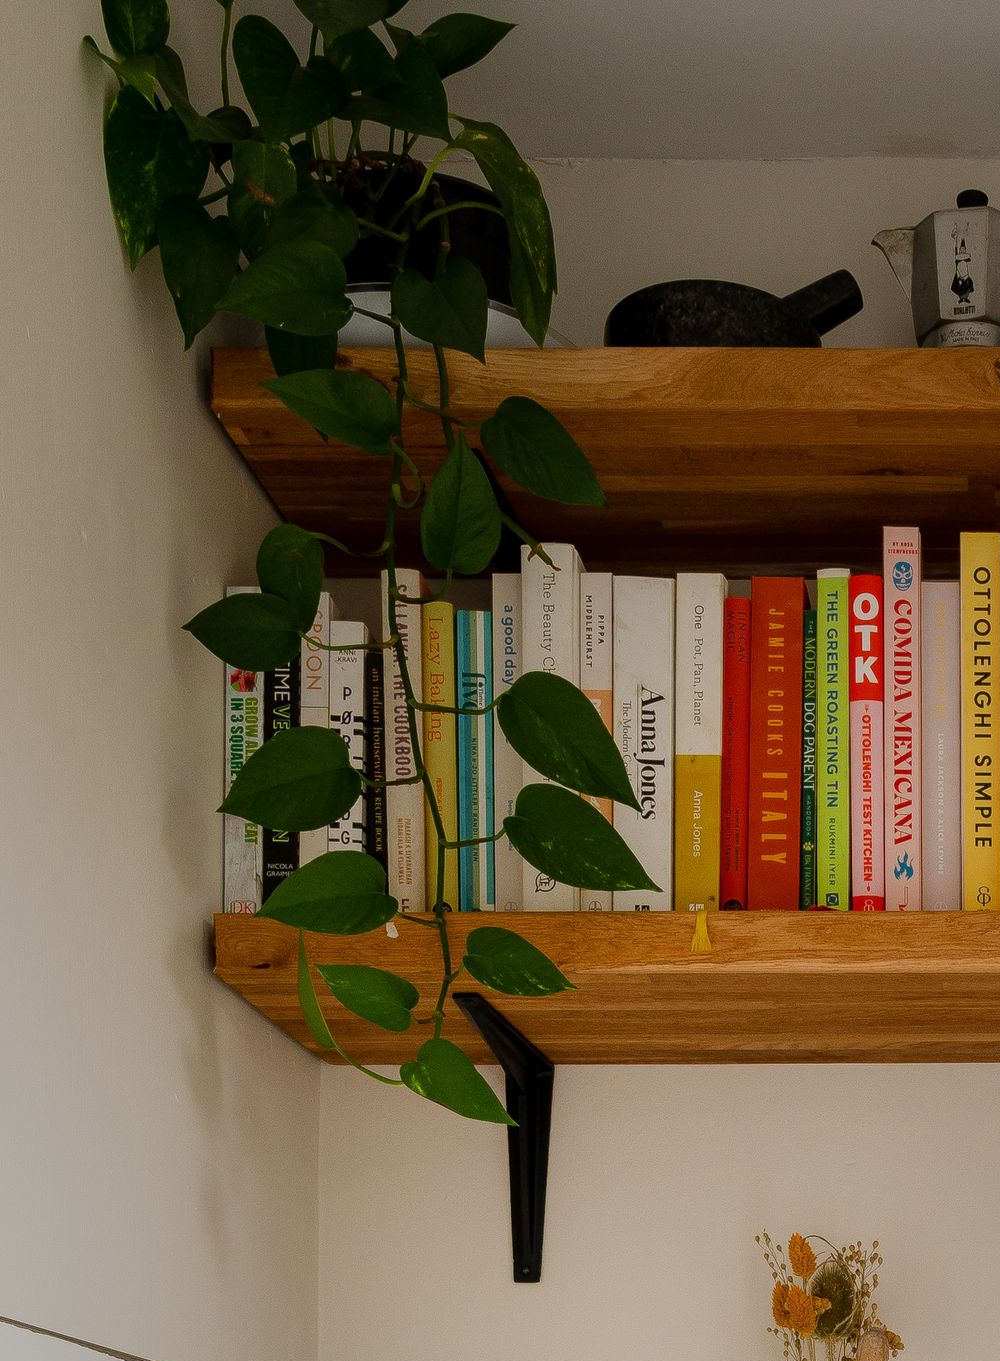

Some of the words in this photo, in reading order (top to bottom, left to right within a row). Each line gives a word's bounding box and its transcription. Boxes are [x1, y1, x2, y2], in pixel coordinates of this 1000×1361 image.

[393, 584, 408, 607] SI
[542, 572, 556, 599] The
[504, 604, 514, 613] a
[694, 605, 705, 630] One
[737, 610, 747, 632] TIN
[826, 590, 839, 623] THE
[424, 616, 444, 666] Lazy
[502, 616, 518, 655] good
[540, 604, 555, 652] Beauty
[585, 595, 593, 668] MIDDLEHURST
[727, 609, 736, 654] MAGIC
[767, 608, 785, 673] JAMIE
[852, 592, 880, 684] OTK
[693, 638, 704, 660] Pot,
[737, 636, 747, 664] CAN
[826, 628, 839, 684] GREEN
[893, 599, 913, 703] COMIDA
[973, 566, 992, 739] OTTOLENGHI
[371, 667, 380, 682] an
[502, 659, 517, 686] day
[692, 663, 704, 688] Pan,
[804, 637, 816, 699] MODERN
[230, 697, 244, 711] IN
[230, 713, 244, 723] 3
[244, 697, 259, 737] GROW
[371, 686, 383, 723] indian
[622, 700, 632, 717] The
[640, 685, 666, 754] Anna
[693, 690, 704, 726] Planet
[803, 702, 816, 733] DOG
[622, 719, 632, 753] Modern
[766, 689, 785, 756] COOKS
[826, 690, 839, 775] ROASTING
[394, 705, 411, 784] COOKBOO
[861, 714, 872, 793] OTTOLENGHI
[937, 733, 945, 762] LAURA
[803, 736, 816, 791] PARENT
[893, 709, 913, 845] MEXICANA
[633, 752, 666, 820] Jones
[826, 781, 839, 808] TIN
[937, 765, 945, 805] JACKSON
[974, 754, 992, 848] SIMPLE
[374, 797, 383, 826] RECIPE
[693, 790, 704, 820] Anna
[760, 771, 788, 864] ITALY
[863, 796, 873, 826] TEST
[244, 823, 259, 845] EAT
[374, 828, 383, 852] BOOK
[692, 822, 703, 858] Jones
[828, 818, 836, 860] RUKMINI
[863, 829, 872, 882] KITCHEN
[828, 863, 836, 886] IYER
[231, 901, 256, 914] DK
